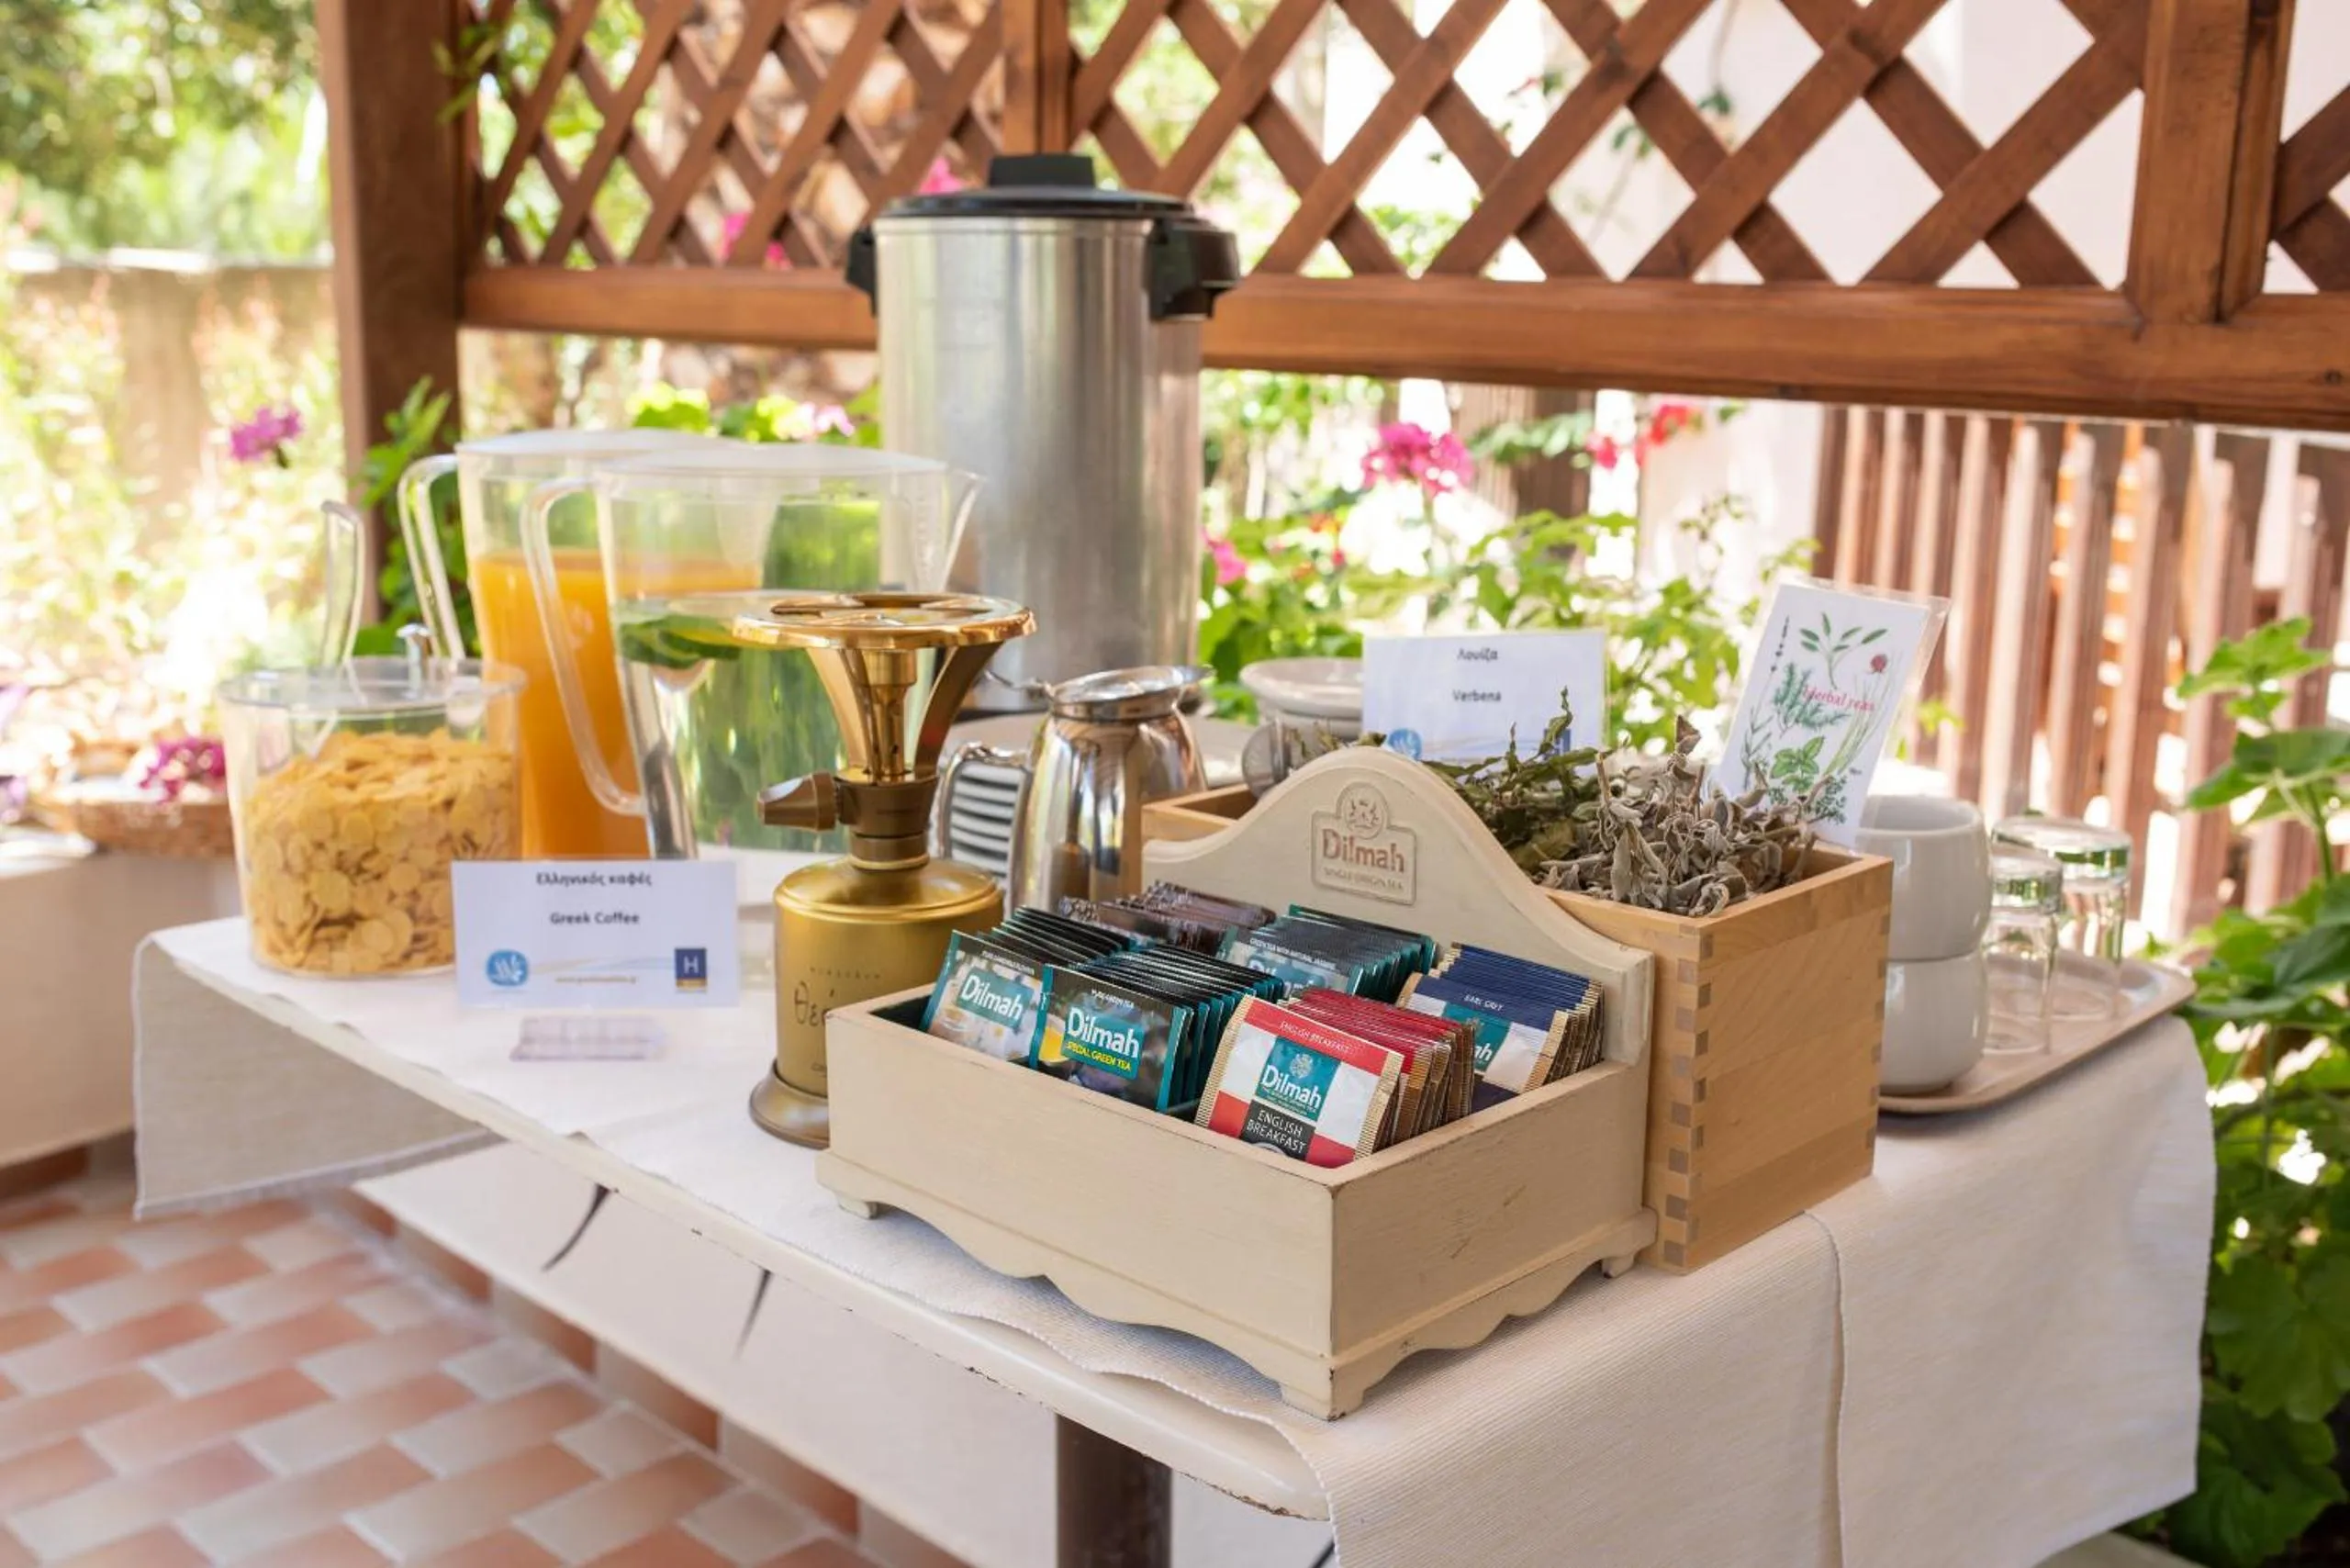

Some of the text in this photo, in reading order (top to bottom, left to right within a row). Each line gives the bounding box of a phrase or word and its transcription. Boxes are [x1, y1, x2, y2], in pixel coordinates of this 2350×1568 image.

[1457, 647, 1498, 661] Λουίζα
[1452, 690, 1502, 702] Verbena
[1803, 685, 1847, 706] Herbal
[1323, 828, 1404, 874] Dilmah
[536, 871, 652, 888] Ελληνικός καφές
[550, 911, 640, 924] Greek Coffee
[683, 957, 699, 973] H
[960, 974, 1024, 1021] Dilmah
[1464, 994, 1483, 1005] EARL
[1068, 1007, 1139, 1058] Dilmah
[1280, 1020, 1310, 1037] ENGLISH
[1066, 1041, 1131, 1071] SPECIAL GREEN TEA
[1262, 1064, 1322, 1109] Dilmah
[1257, 1109, 1304, 1137] ENGLISH
[1247, 1119, 1307, 1154] BREAKFAST
